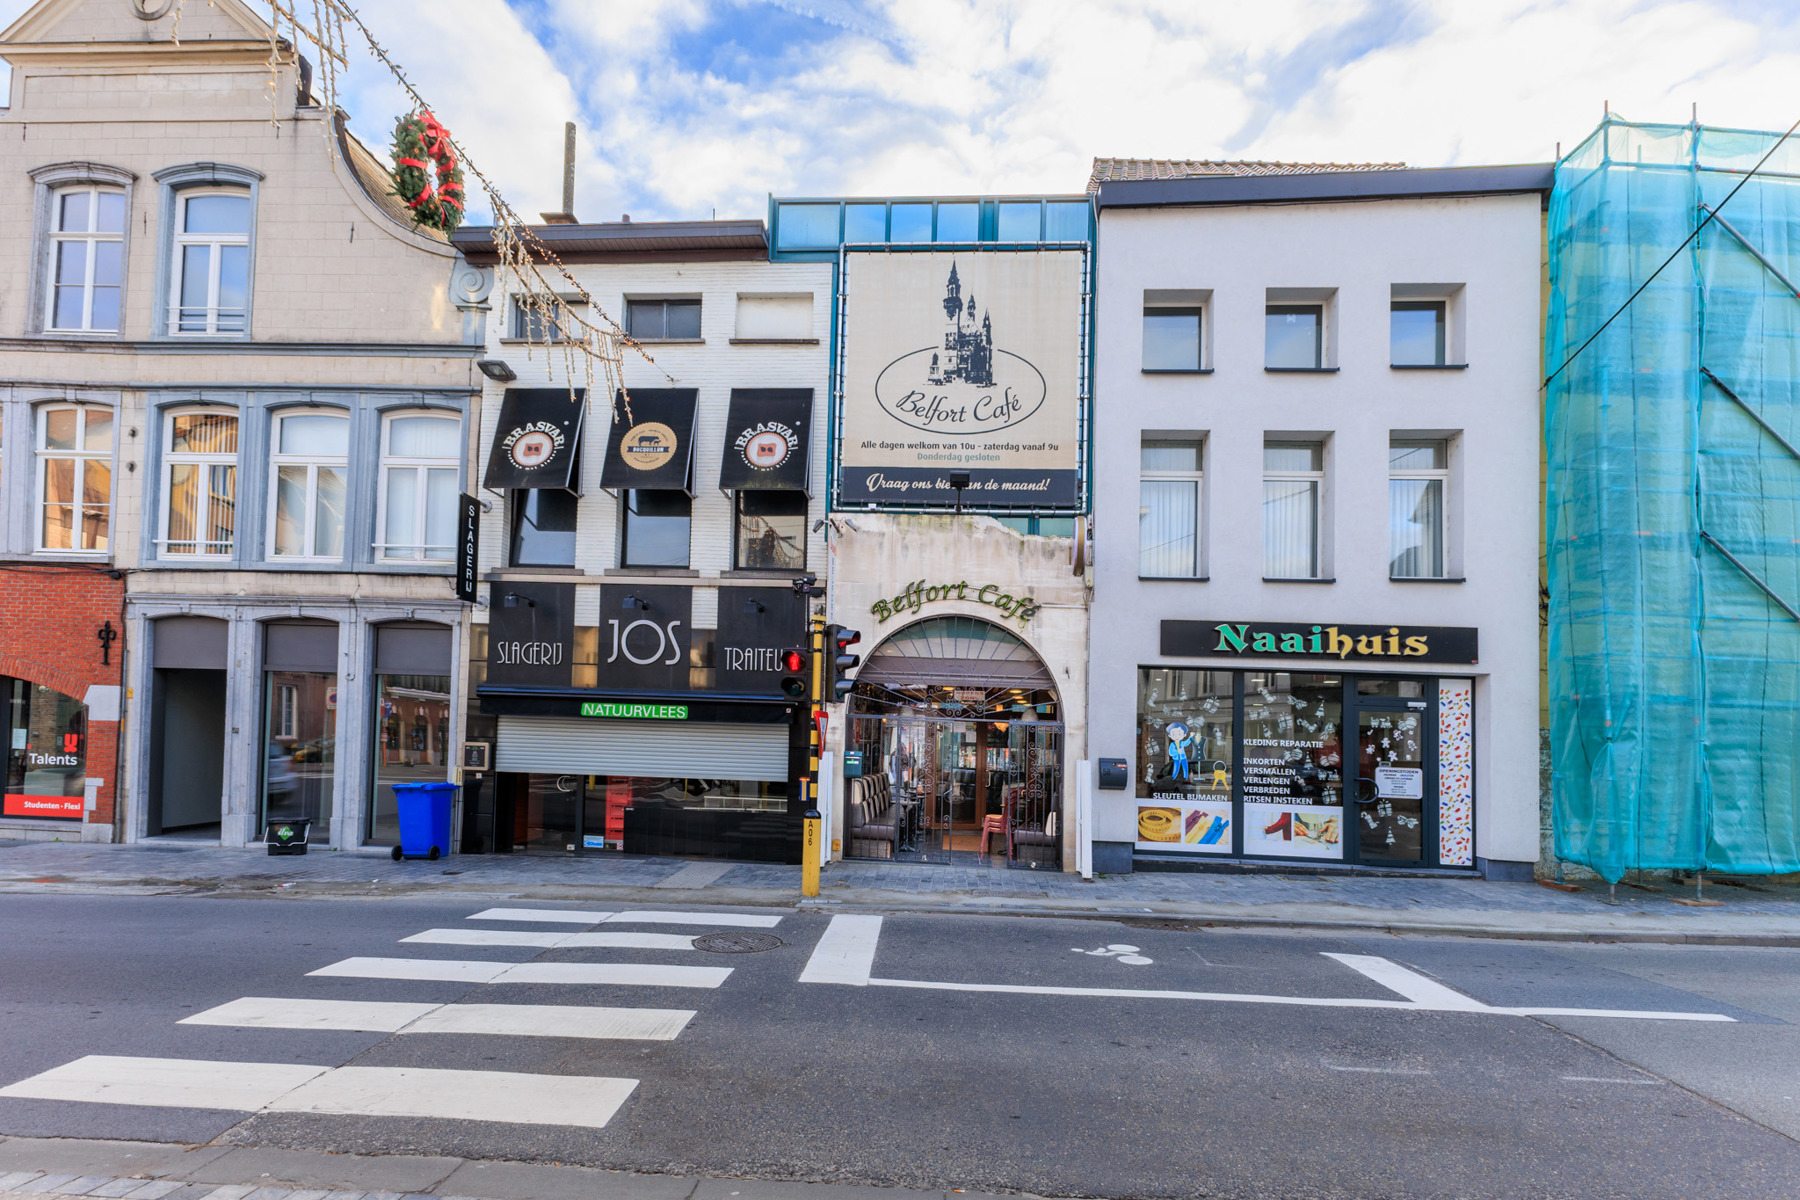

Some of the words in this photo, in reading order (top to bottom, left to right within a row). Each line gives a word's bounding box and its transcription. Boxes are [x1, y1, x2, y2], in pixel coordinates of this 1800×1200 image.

[896, 390, 967, 426] Belfort
[973, 386, 1022, 423] Café
[502, 421, 565, 447] BRASVAR
[735, 421, 799, 447] BRASVAR
[861, 441, 877, 450] Alle
[879, 441, 905, 452] dagen
[907, 441, 940, 450] welkom
[960, 442, 976, 450] 10u
[983, 442, 1020, 453] zaterdag
[1022, 442, 1046, 451] vanaf
[1048, 443, 1059, 451] 9u
[917, 452, 962, 462] Donderdag
[964, 453, 1001, 463] gesloten
[866, 472, 910, 492] Vraag
[912, 481, 932, 490] ons
[984, 479, 999, 490] de
[1001, 478, 1051, 491] maand!
[871, 578, 968, 623] Belfort
[978, 584, 1042, 622] Café
[606, 619, 681, 666] JOS
[1212, 623, 1430, 660] Naaihuis
[496, 641, 563, 666] SLAGERIJ
[724, 648, 785, 672] TRAITEU
[583, 703, 686, 719] NATUURVLEES
[1243, 739, 1277, 748] KLEDING
[1279, 740, 1324, 749] REPARATIE
[28, 753, 78, 766] Talents
[1243, 757, 1286, 766] INKORTEN
[1243, 767, 1296, 776] VERSMALLEN
[1243, 776, 1291, 785] VERLENGEN
[1153, 791, 1186, 800] SLEUTEL
[1187, 793, 1228, 802] BIJMAKEN
[1243, 786, 1291, 795] VERBREDEN
[24, 801, 60, 809] Studenten
[64, 802, 81, 810] Flexi
[1243, 795, 1271, 804] RITSEN
[1273, 797, 1313, 806] INSTEKEN
